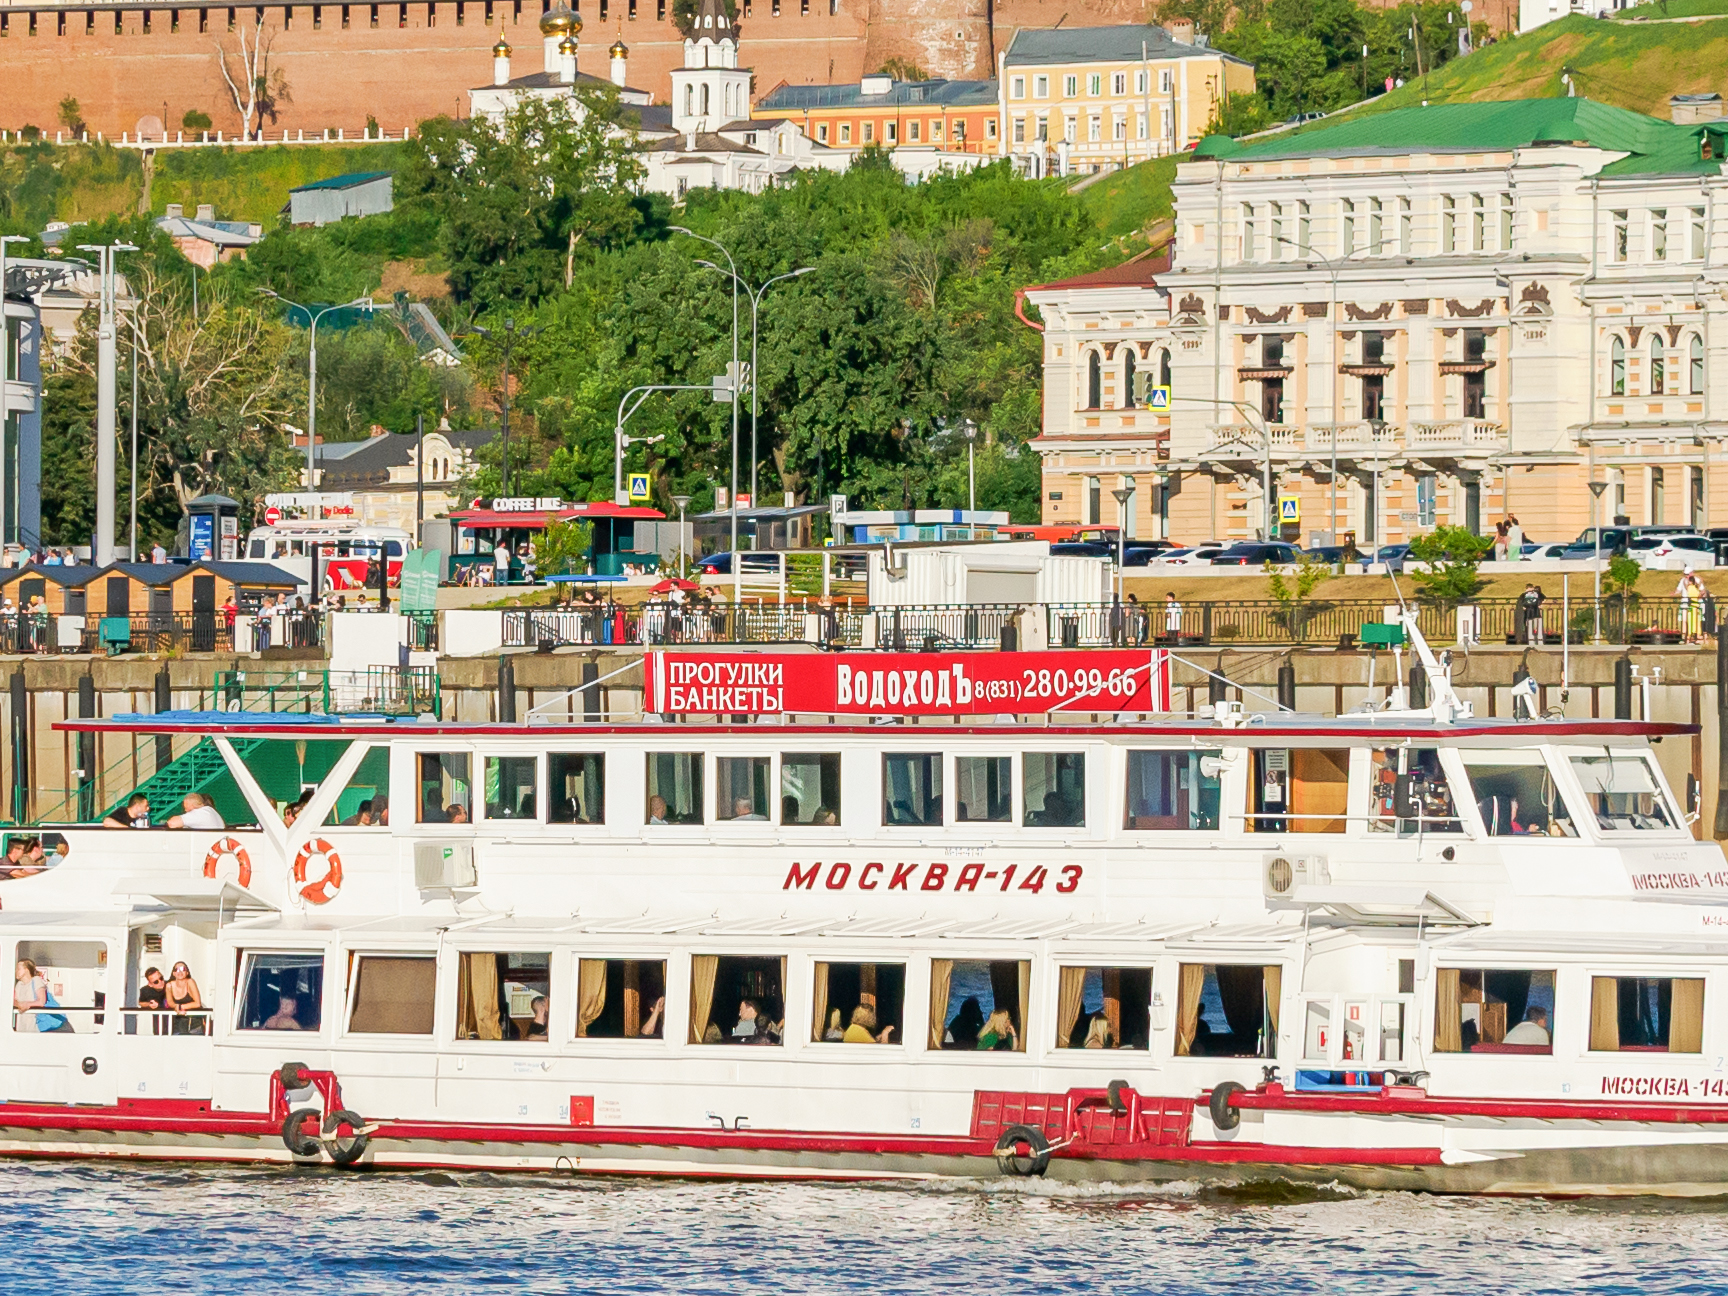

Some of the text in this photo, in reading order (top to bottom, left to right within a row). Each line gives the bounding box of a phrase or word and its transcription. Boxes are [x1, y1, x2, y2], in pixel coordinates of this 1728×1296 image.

[493, 497, 535, 511] COFFEE
[669, 662, 784, 685] ПРОГУЛКИ
[669, 687, 784, 711] БАНКЕТЫ
[974, 680, 1022, 703] 8(831)
[783, 862, 1083, 894] МОСКВА-143
